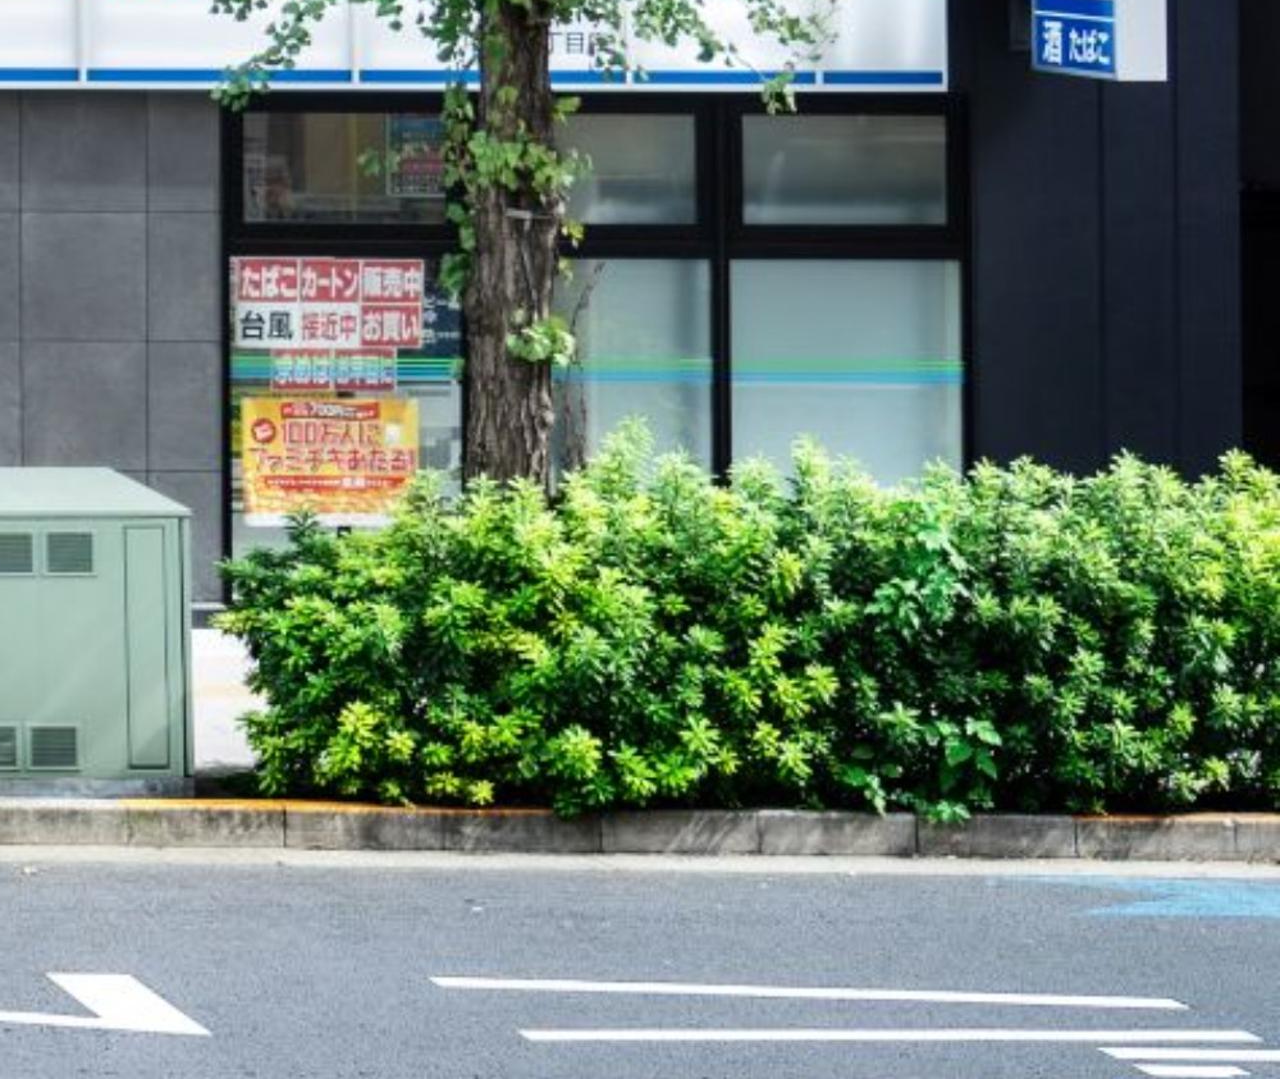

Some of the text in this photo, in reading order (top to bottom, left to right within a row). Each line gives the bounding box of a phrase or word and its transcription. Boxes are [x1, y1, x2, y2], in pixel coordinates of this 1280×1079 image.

[1042, 20, 1111, 65] 酒 たばこ
